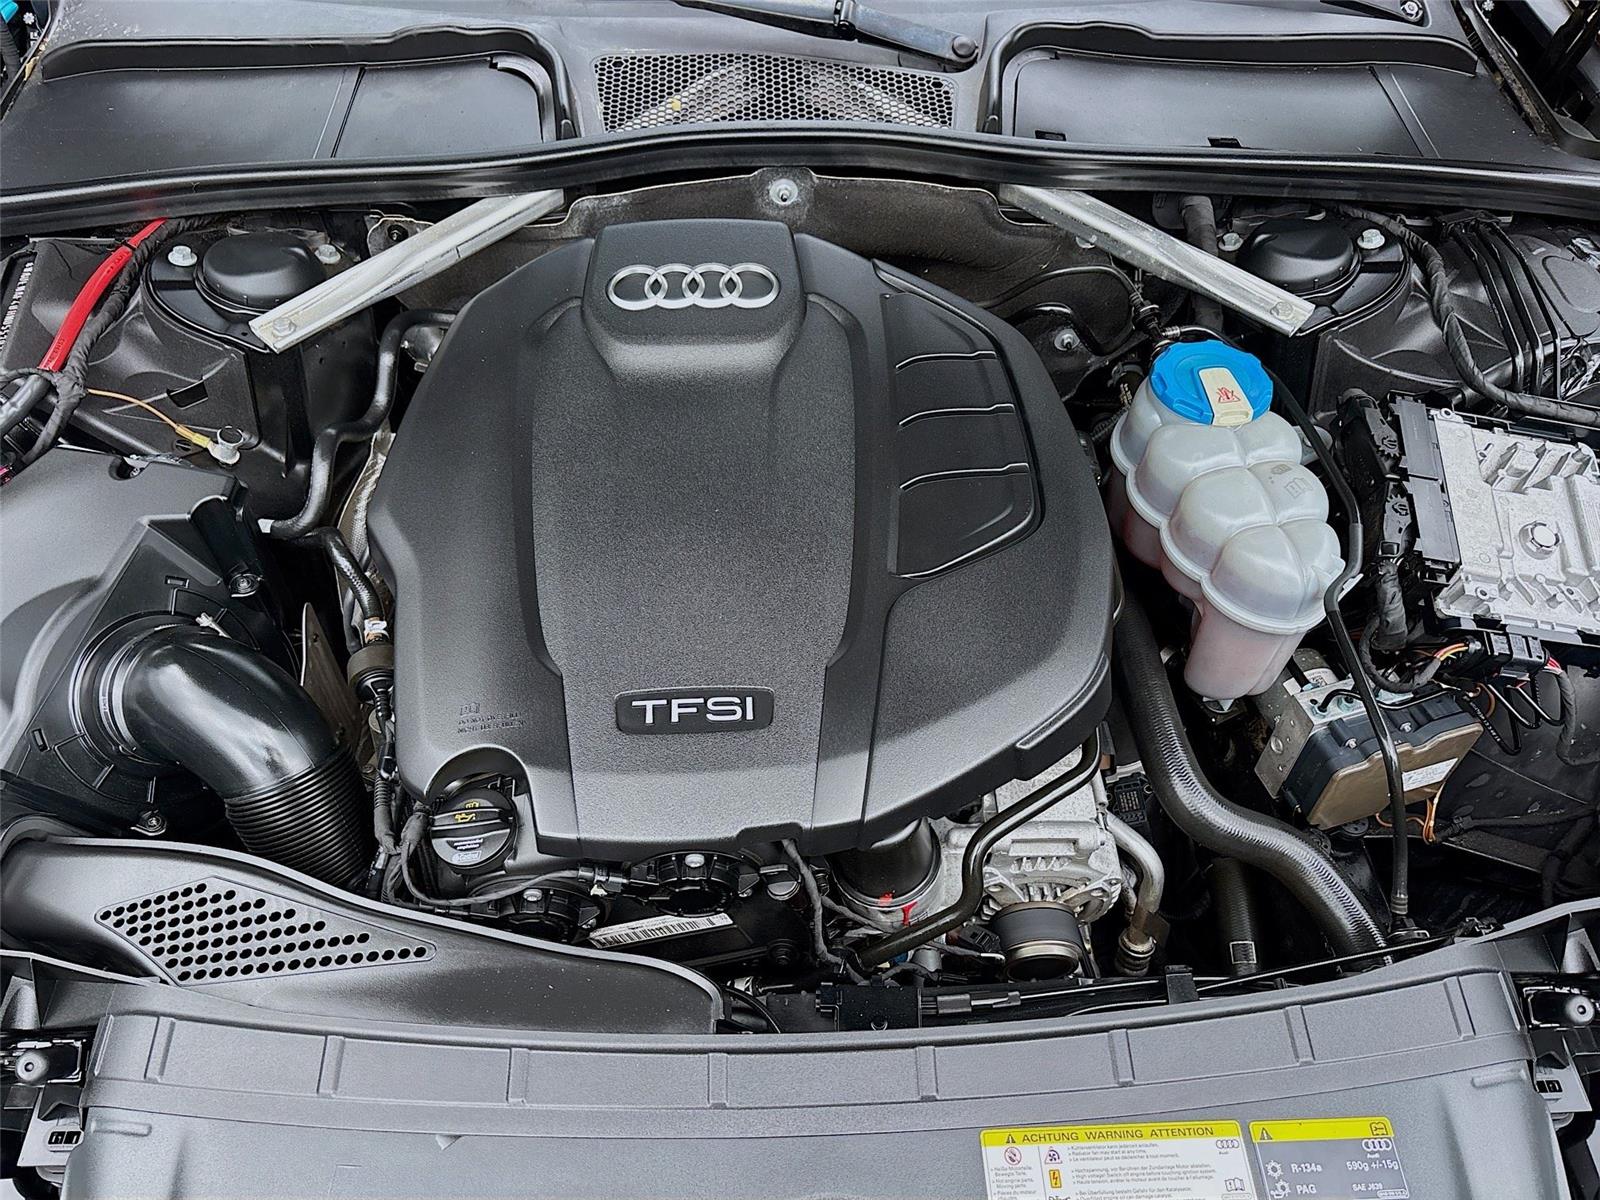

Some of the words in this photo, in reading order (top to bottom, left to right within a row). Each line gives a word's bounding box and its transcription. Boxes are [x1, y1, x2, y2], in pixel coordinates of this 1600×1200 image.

[631, 696, 754, 724] TFSI
[1022, 1132, 1078, 1142] ACHTUNG
[1084, 1130, 1144, 1140] WARNING
[1150, 1127, 1214, 1138] ATTENTION
[1290, 1162, 1322, 1174] R-134a
[1296, 1184, 1316, 1194] PAG
